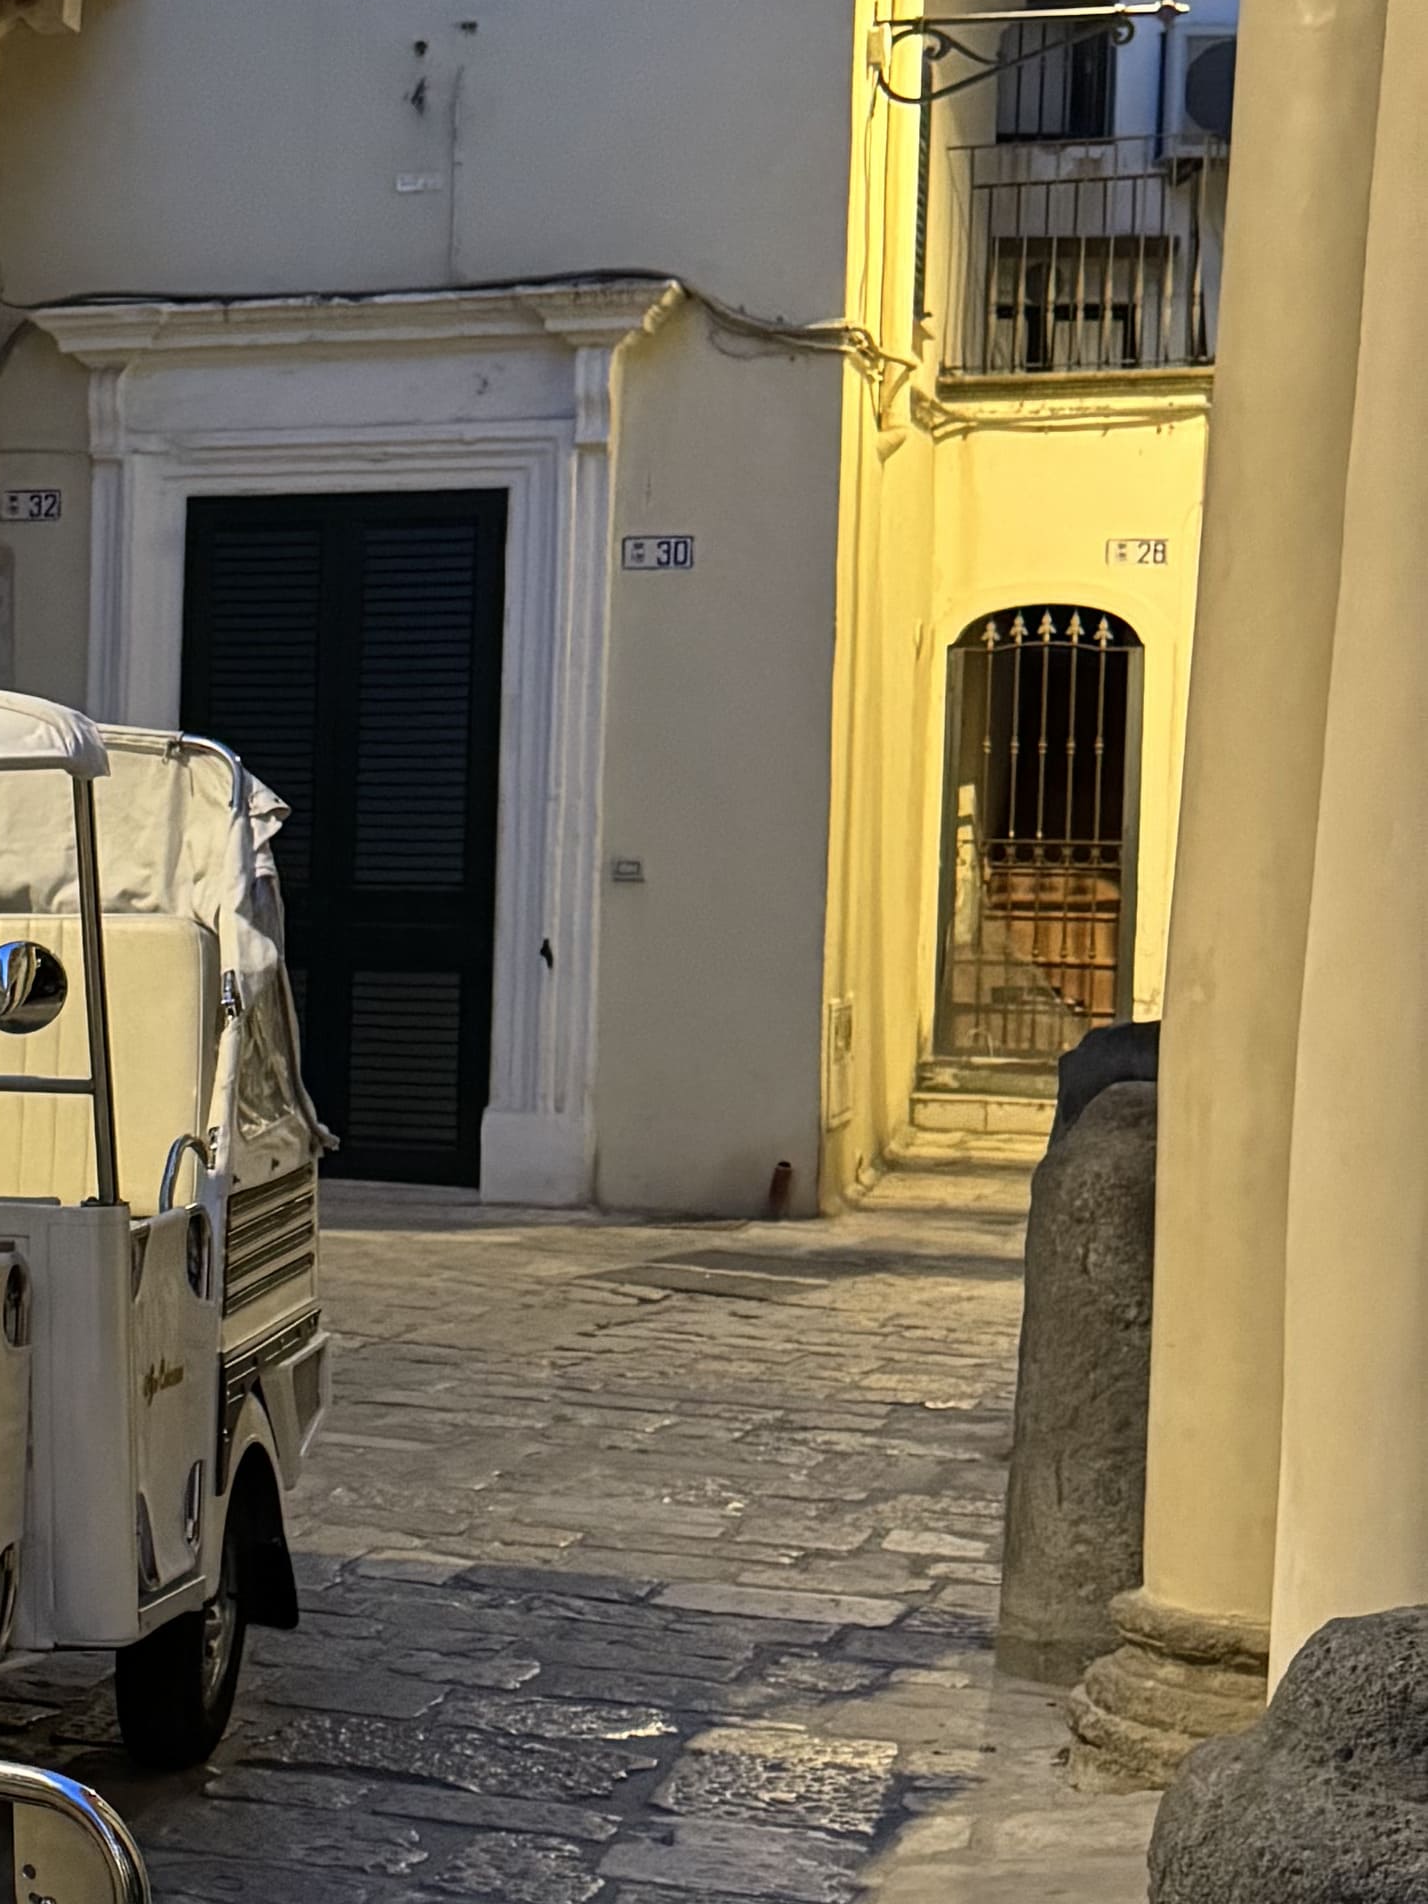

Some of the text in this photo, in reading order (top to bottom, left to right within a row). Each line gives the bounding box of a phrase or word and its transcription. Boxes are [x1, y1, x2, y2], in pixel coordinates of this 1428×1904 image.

[30, 494, 57, 517] 32
[657, 540, 688, 566] 30
[1137, 541, 1166, 564] 28
